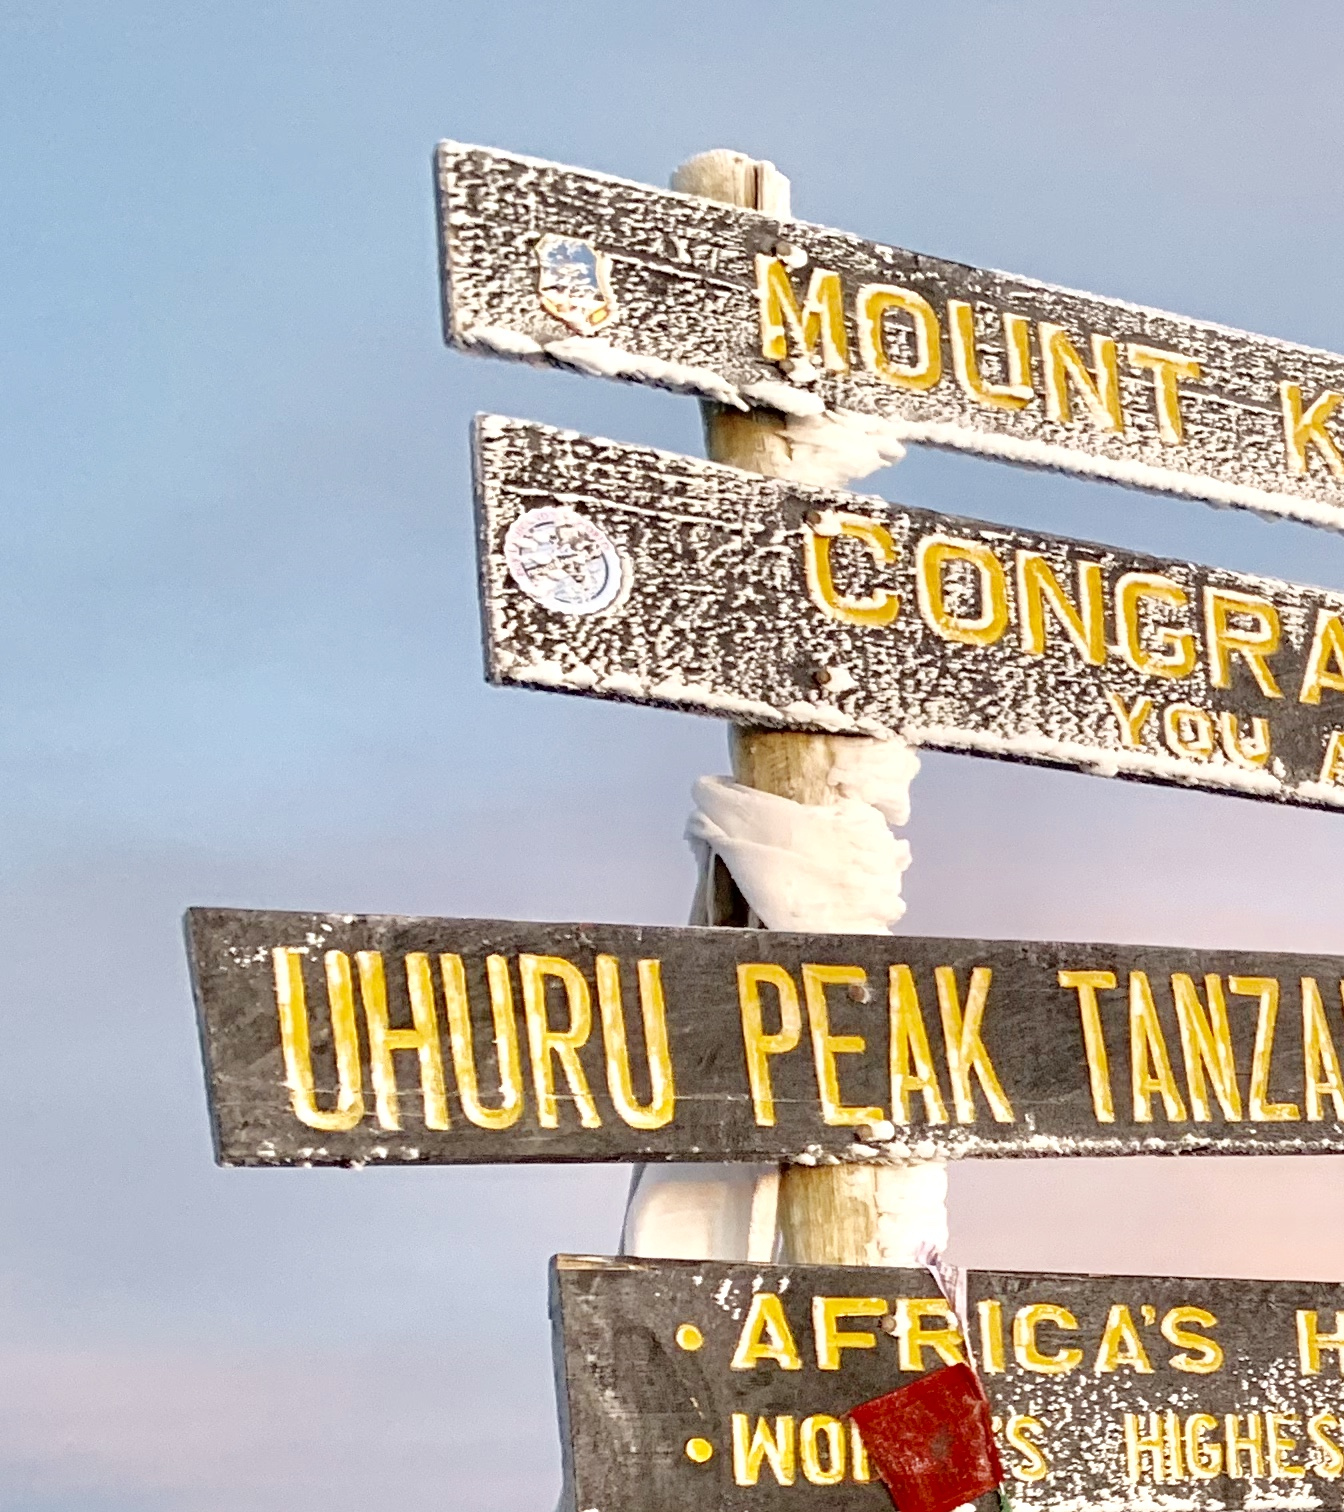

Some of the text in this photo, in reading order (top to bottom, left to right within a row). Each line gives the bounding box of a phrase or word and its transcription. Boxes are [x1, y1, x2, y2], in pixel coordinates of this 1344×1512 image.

[757, 254, 1202, 445] MOUNT
[1104, 688, 1271, 769] YOU
[272, 947, 676, 1132] UHURU
[737, 962, 1016, 1127] PEAK
[730, 1292, 1225, 1376] AFRICA'S
